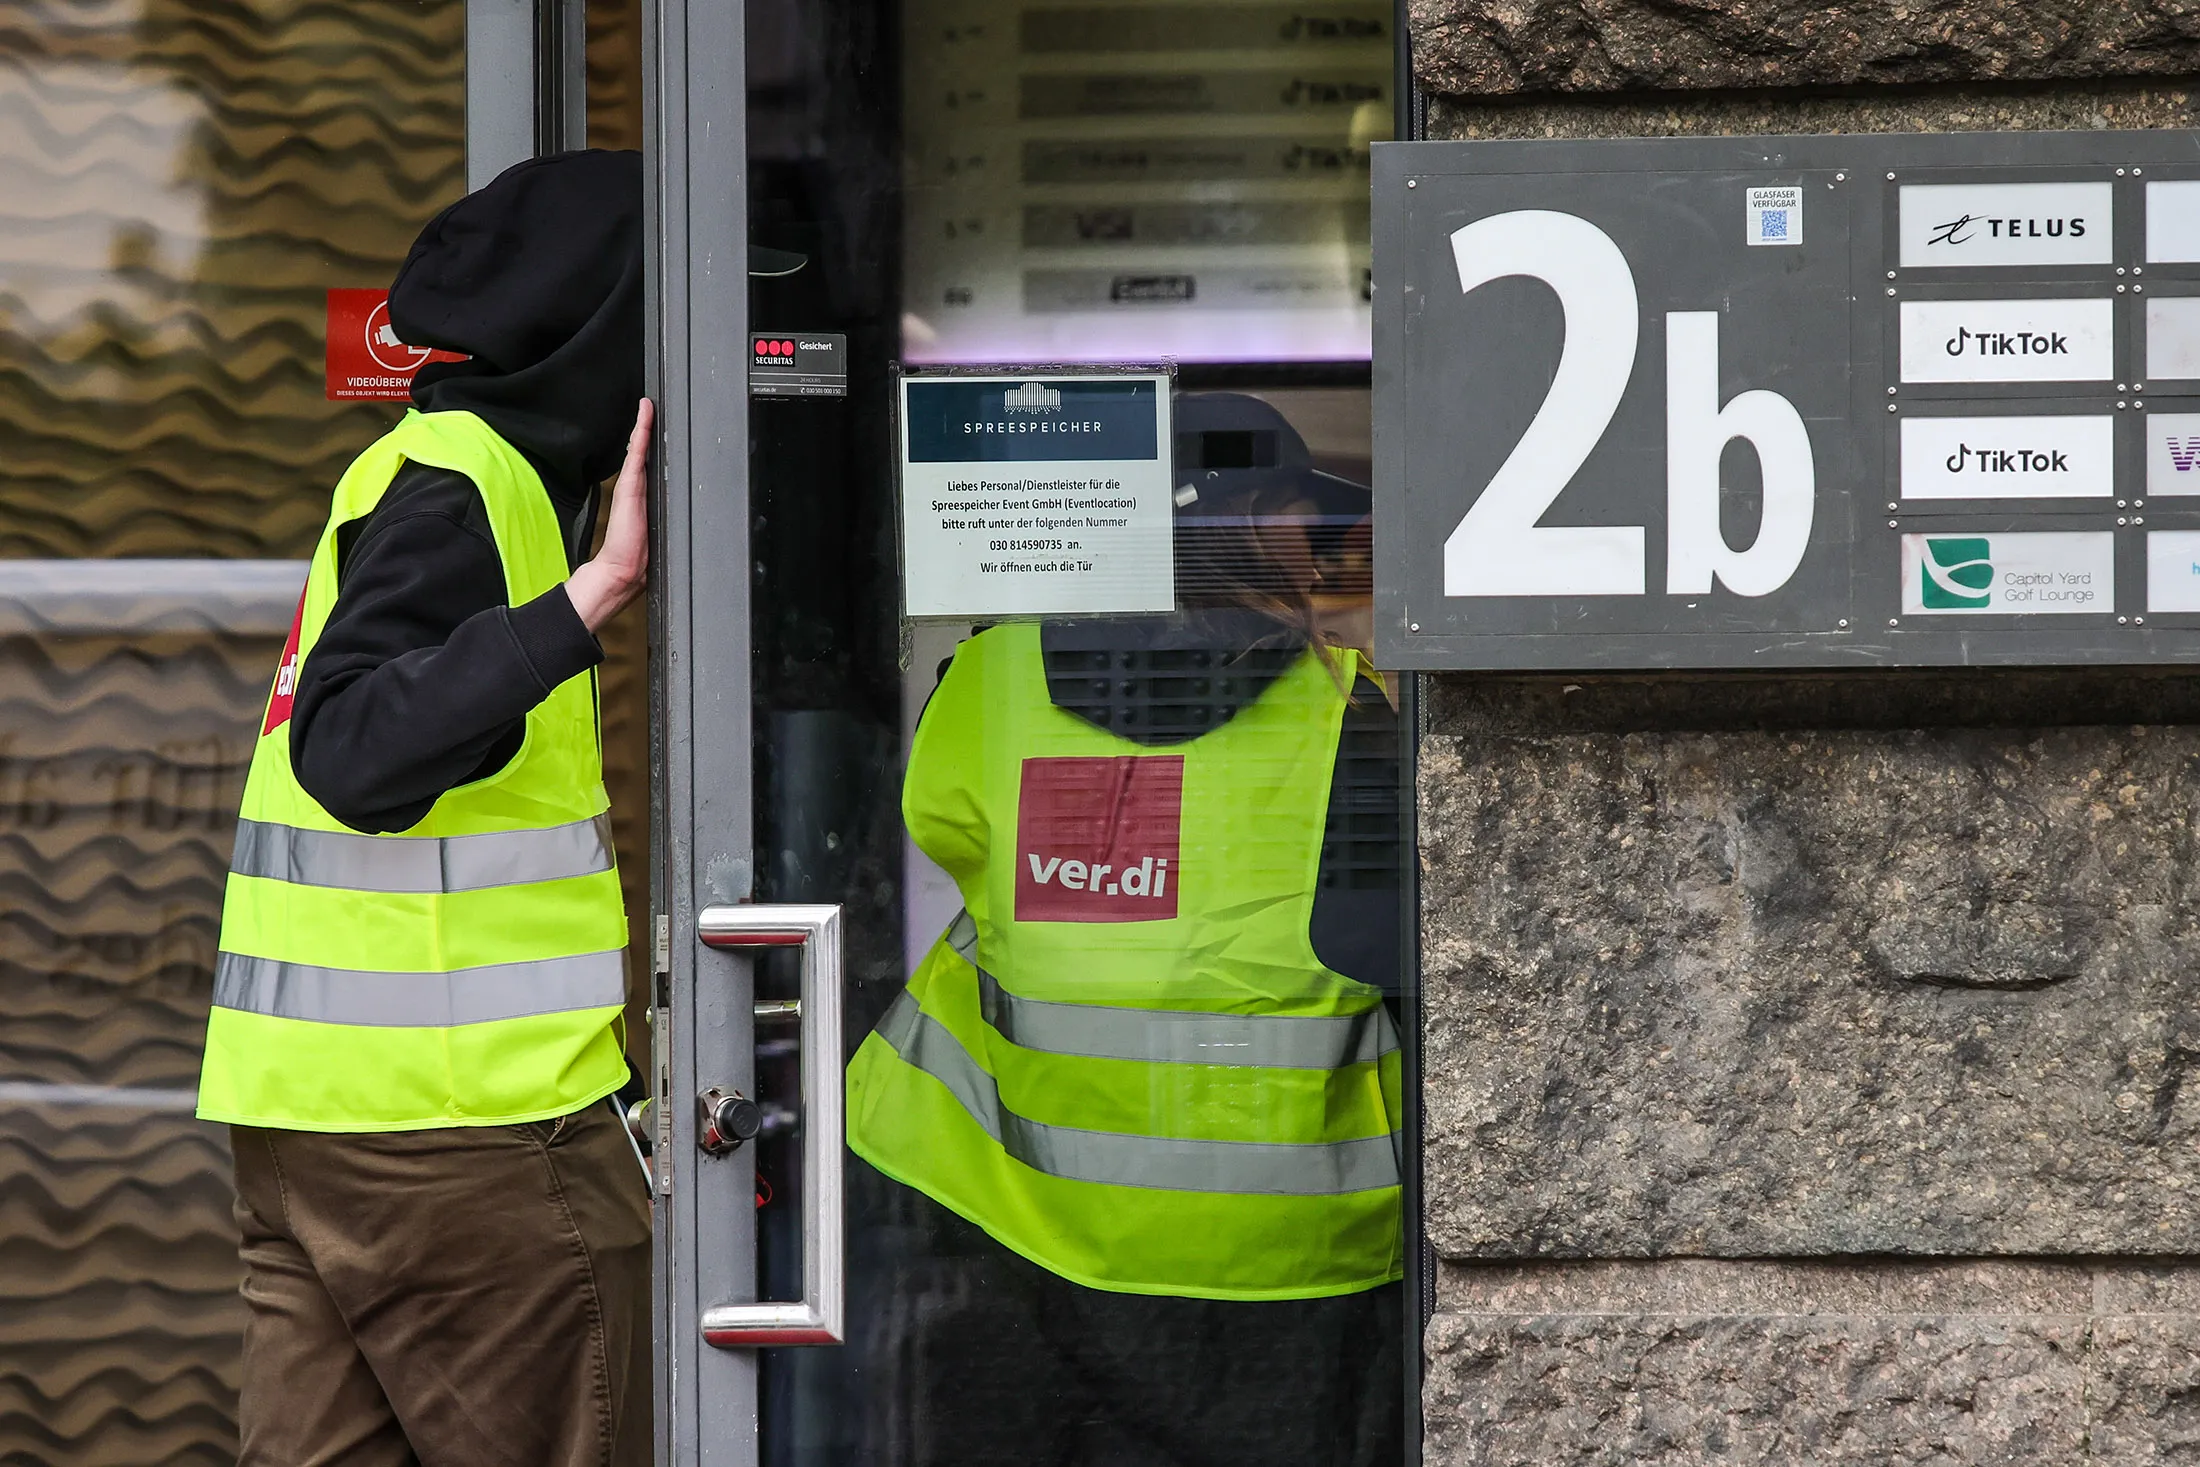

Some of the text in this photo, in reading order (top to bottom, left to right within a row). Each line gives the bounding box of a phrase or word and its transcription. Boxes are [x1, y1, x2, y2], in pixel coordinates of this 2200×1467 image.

[1753, 190, 1796, 199] GLASFASER
[1752, 198, 1797, 207] VERFÜGBAR
[1987, 217, 2086, 239] TELUS
[799, 341, 833, 351] Gesichert
[1975, 331, 2069, 356] TikTok
[755, 357, 794, 365] SECURITAS
[1444, 209, 1816, 598] 2b
[964, 421, 1102, 434] SPREESPEICHER
[1976, 449, 2069, 473] TikTok
[947, 479, 1120, 492] Liebes Personal/Dienstleister für die
[931, 497, 1137, 513] Spreespeicher Event GmbH (Eventlocation)
[942, 517, 1128, 531] bitte ruft unter der folgenden Nummer
[989, 540, 1082, 551] 030 814590735 an.
[980, 561, 1093, 573] Wir öffnen euch die Tür
[2004, 571, 2091, 587] Capitol Yard
[2004, 588, 2094, 604] Golf Lounge
[1027, 853, 1168, 898] ver.di
